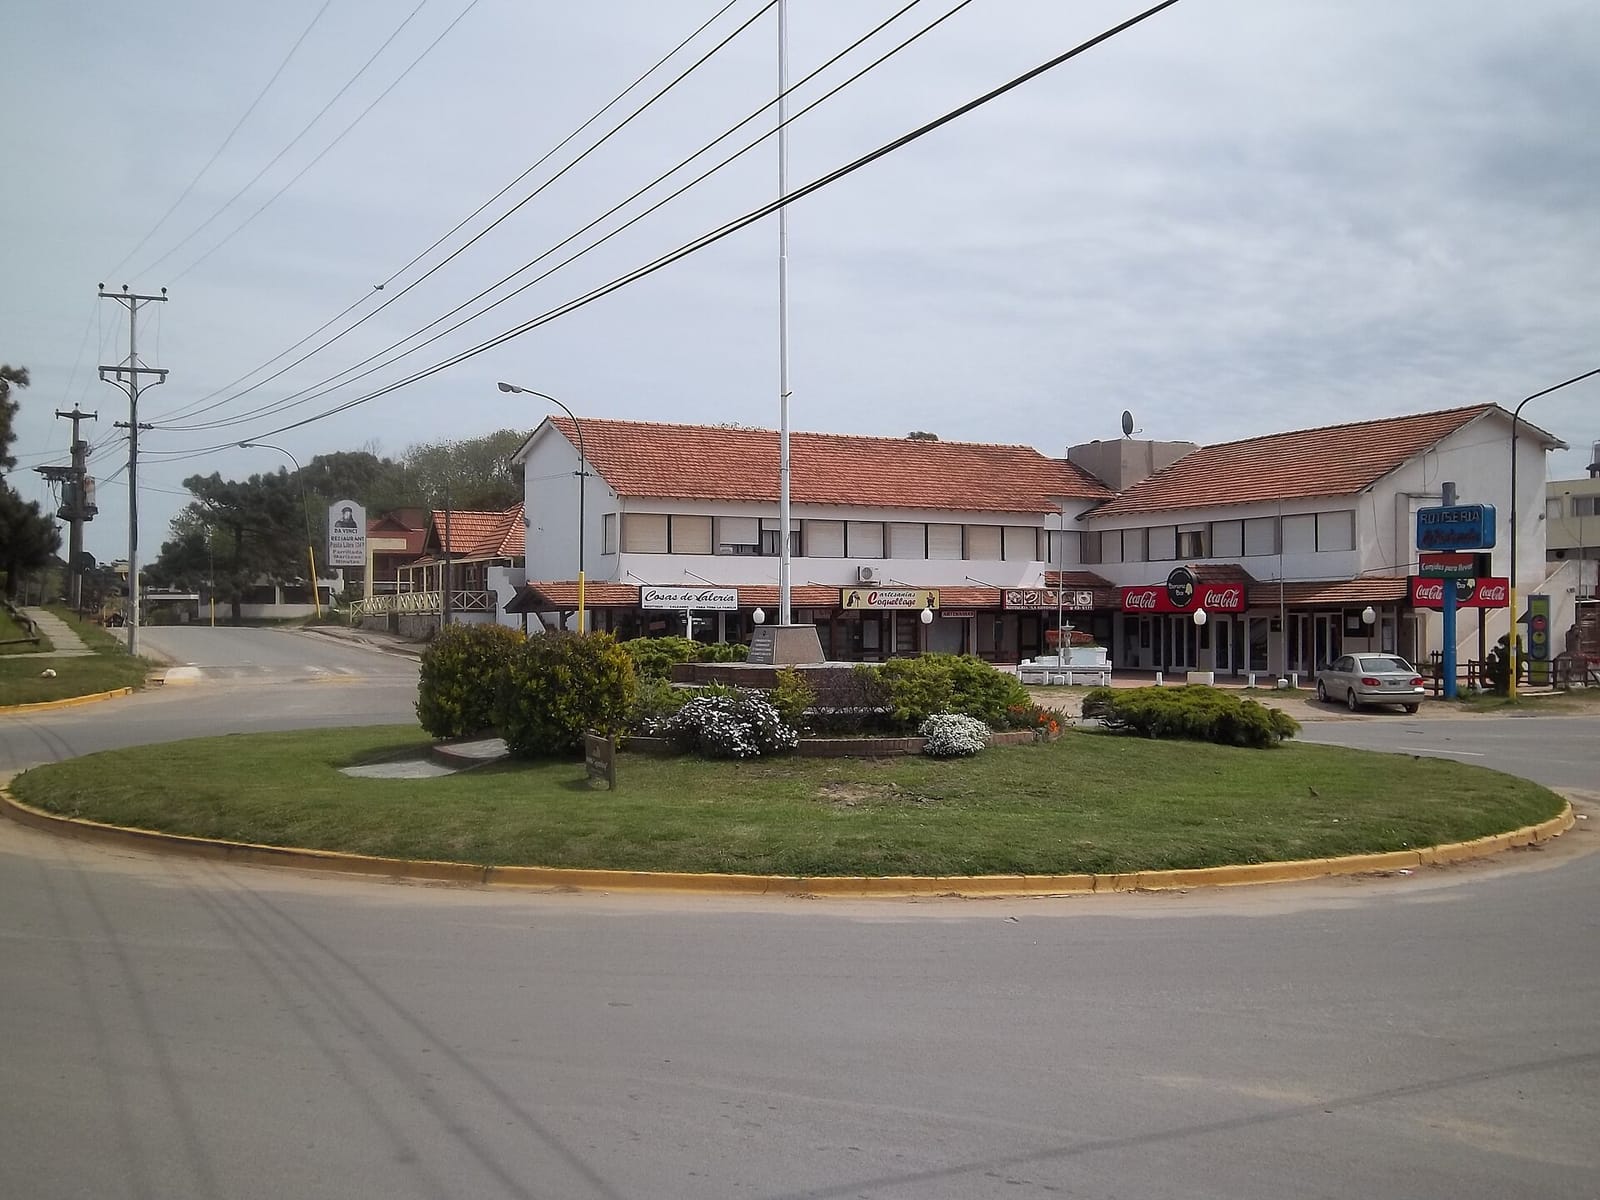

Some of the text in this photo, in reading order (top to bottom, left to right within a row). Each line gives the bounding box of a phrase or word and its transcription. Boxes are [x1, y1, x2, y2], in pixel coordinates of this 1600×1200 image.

[1445, 565, 1458, 573] para
[645, 590, 735, 602] Cosas de Valeria
